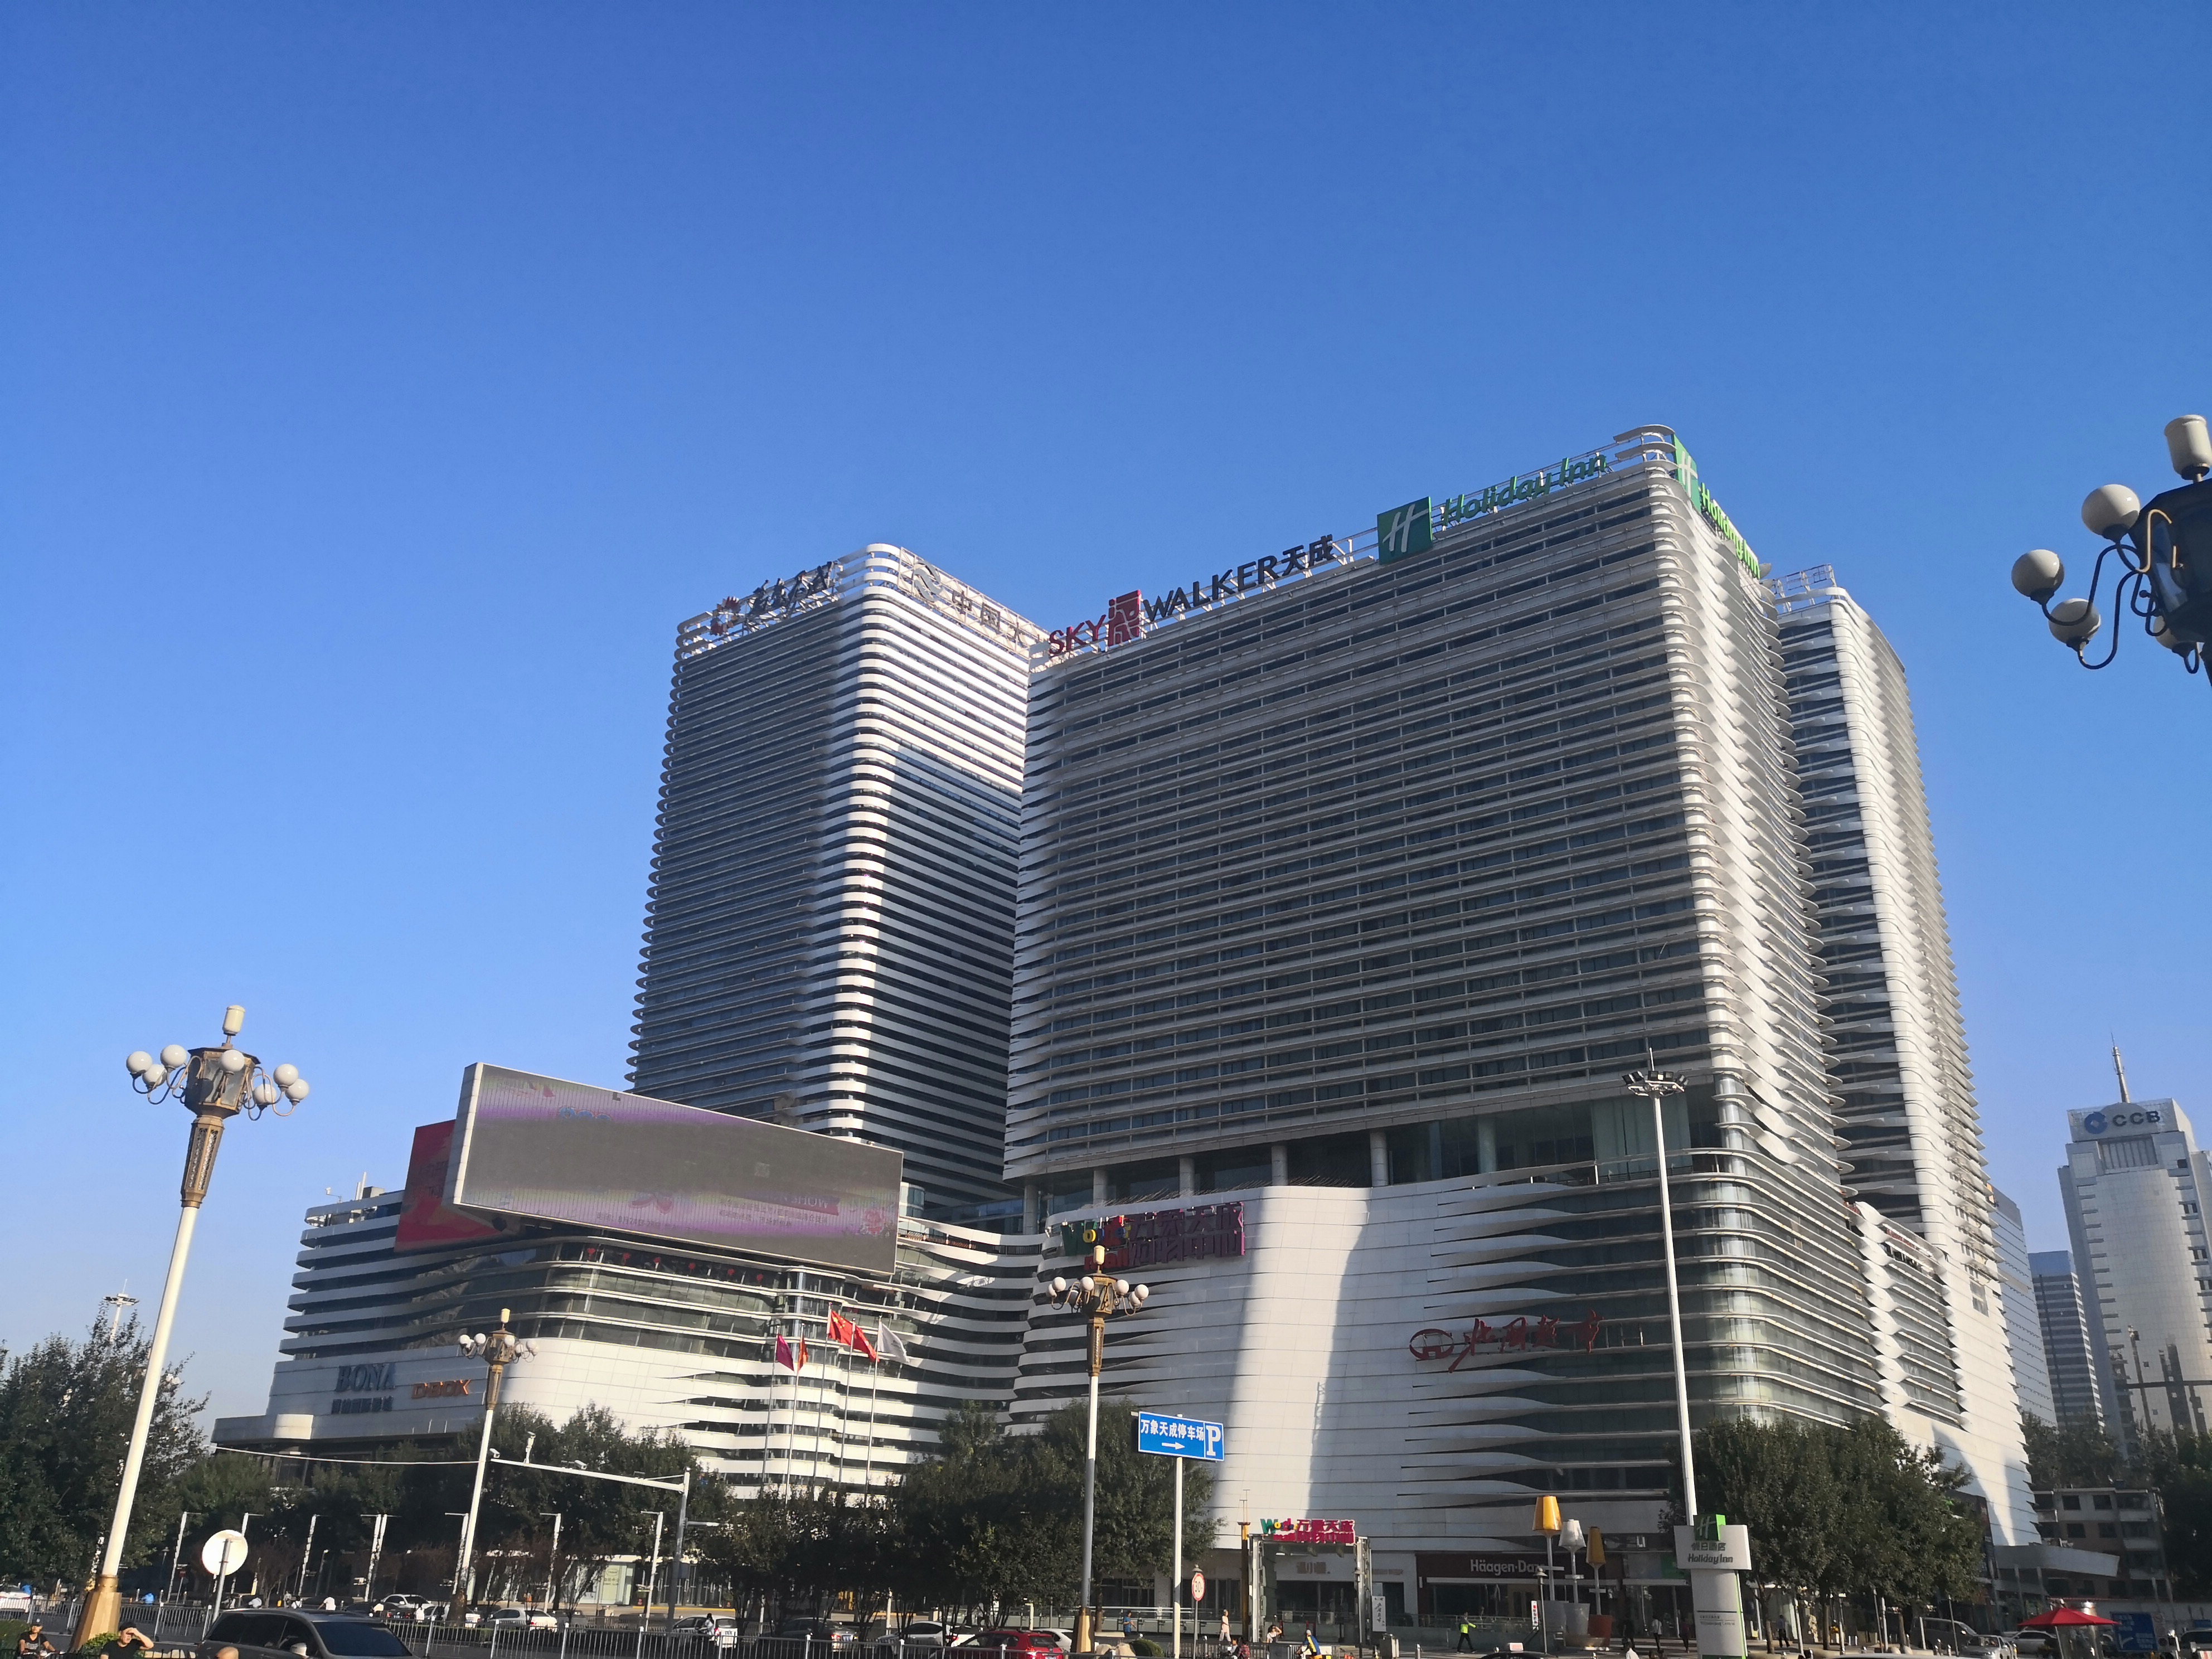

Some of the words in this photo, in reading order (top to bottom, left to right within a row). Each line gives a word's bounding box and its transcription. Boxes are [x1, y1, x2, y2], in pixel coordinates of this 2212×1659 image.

[1440, 472, 1553, 526] Holiday
[1558, 454, 1607, 487] Inn
[1701, 482, 1743, 561] Holiday
[1742, 539, 1760, 580] Inn
[952, 590, 1048, 648] 中国大
[1049, 614, 1107, 658] SKY
[2112, 1110, 2161, 1127] CCB
[334, 1362, 396, 1393] BONA
[1140, 1419, 1204, 1442] 万象天成停车场
[1205, 1424, 1221, 1457] P
[1687, 1553, 1720, 1565] Holiday
[1720, 1553, 1734, 1563] Inn
